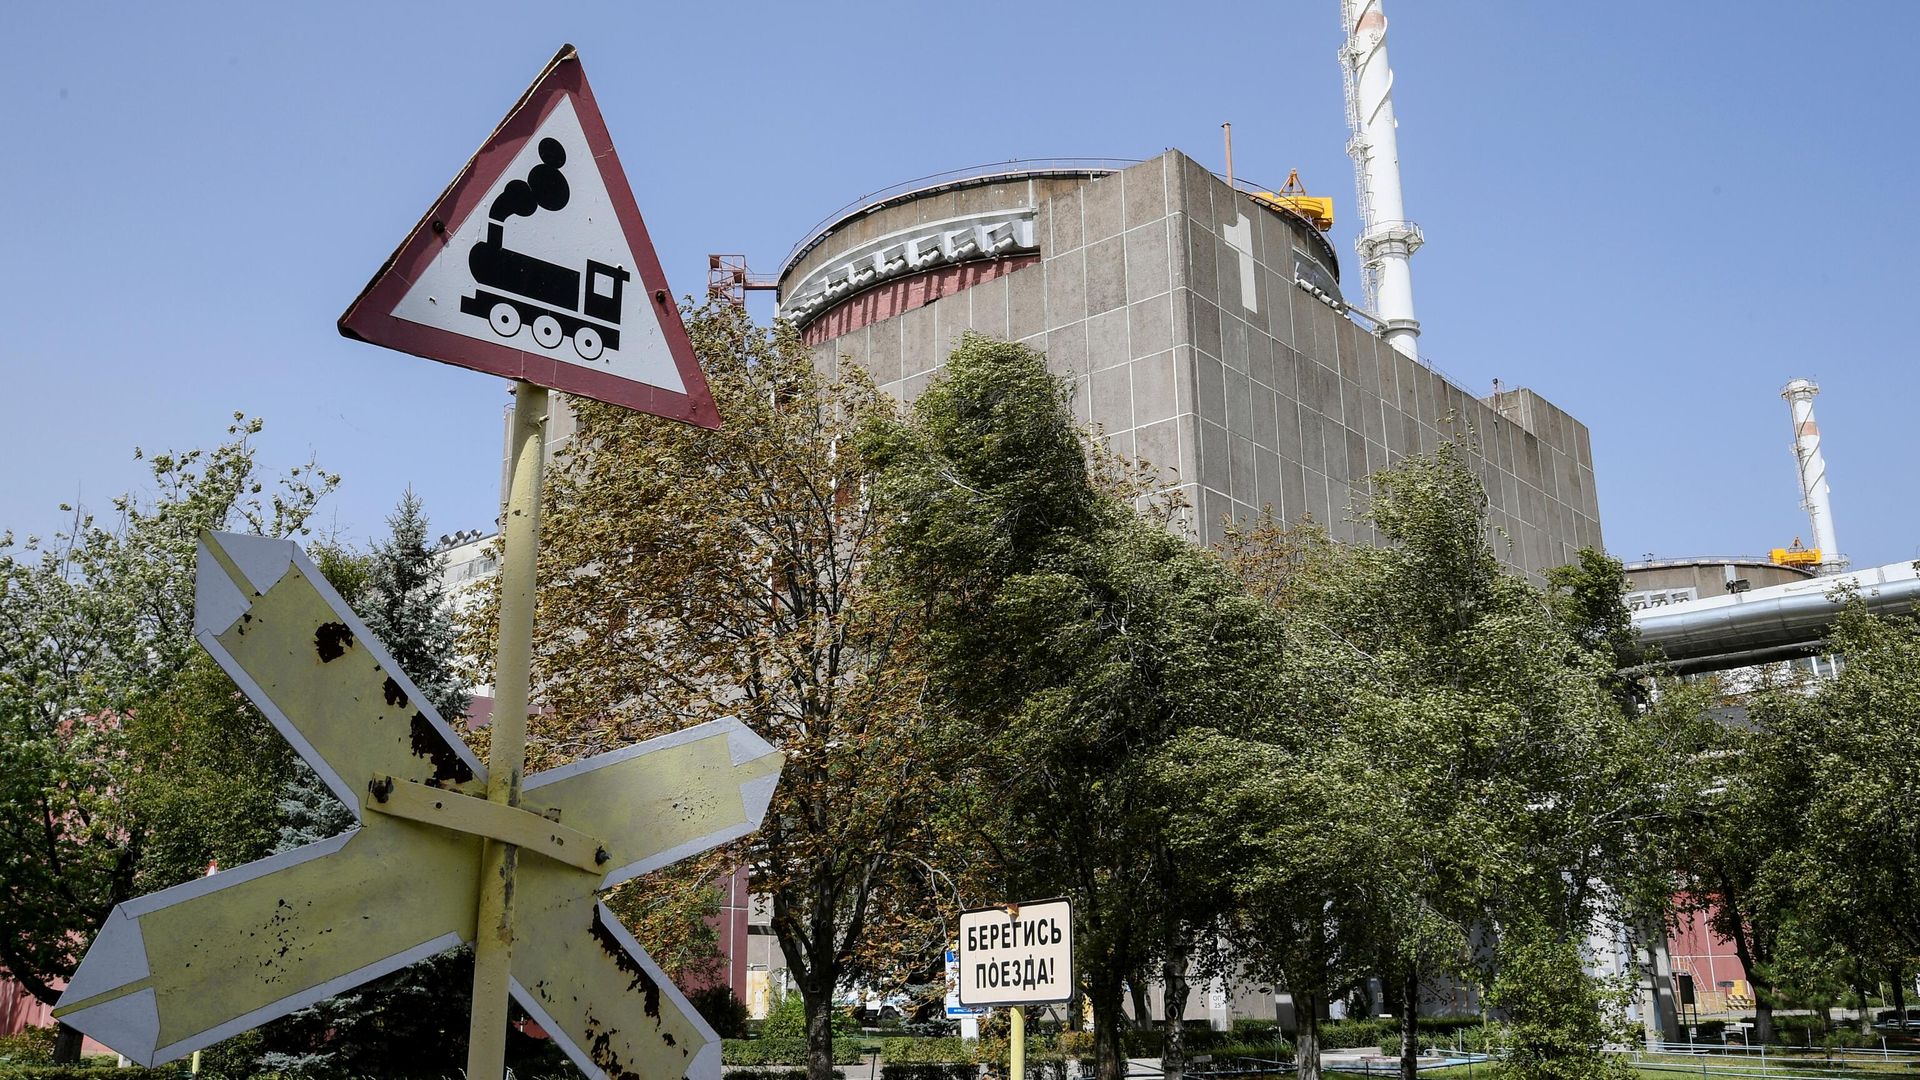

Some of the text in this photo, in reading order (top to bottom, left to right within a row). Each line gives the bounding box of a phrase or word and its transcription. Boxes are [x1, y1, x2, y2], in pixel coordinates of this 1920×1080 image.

[1223, 212, 1257, 314] 1
[968, 918, 1062, 951] БЕРЕГИСЬ
[976, 957, 1054, 991] ПОЕЗДА!
